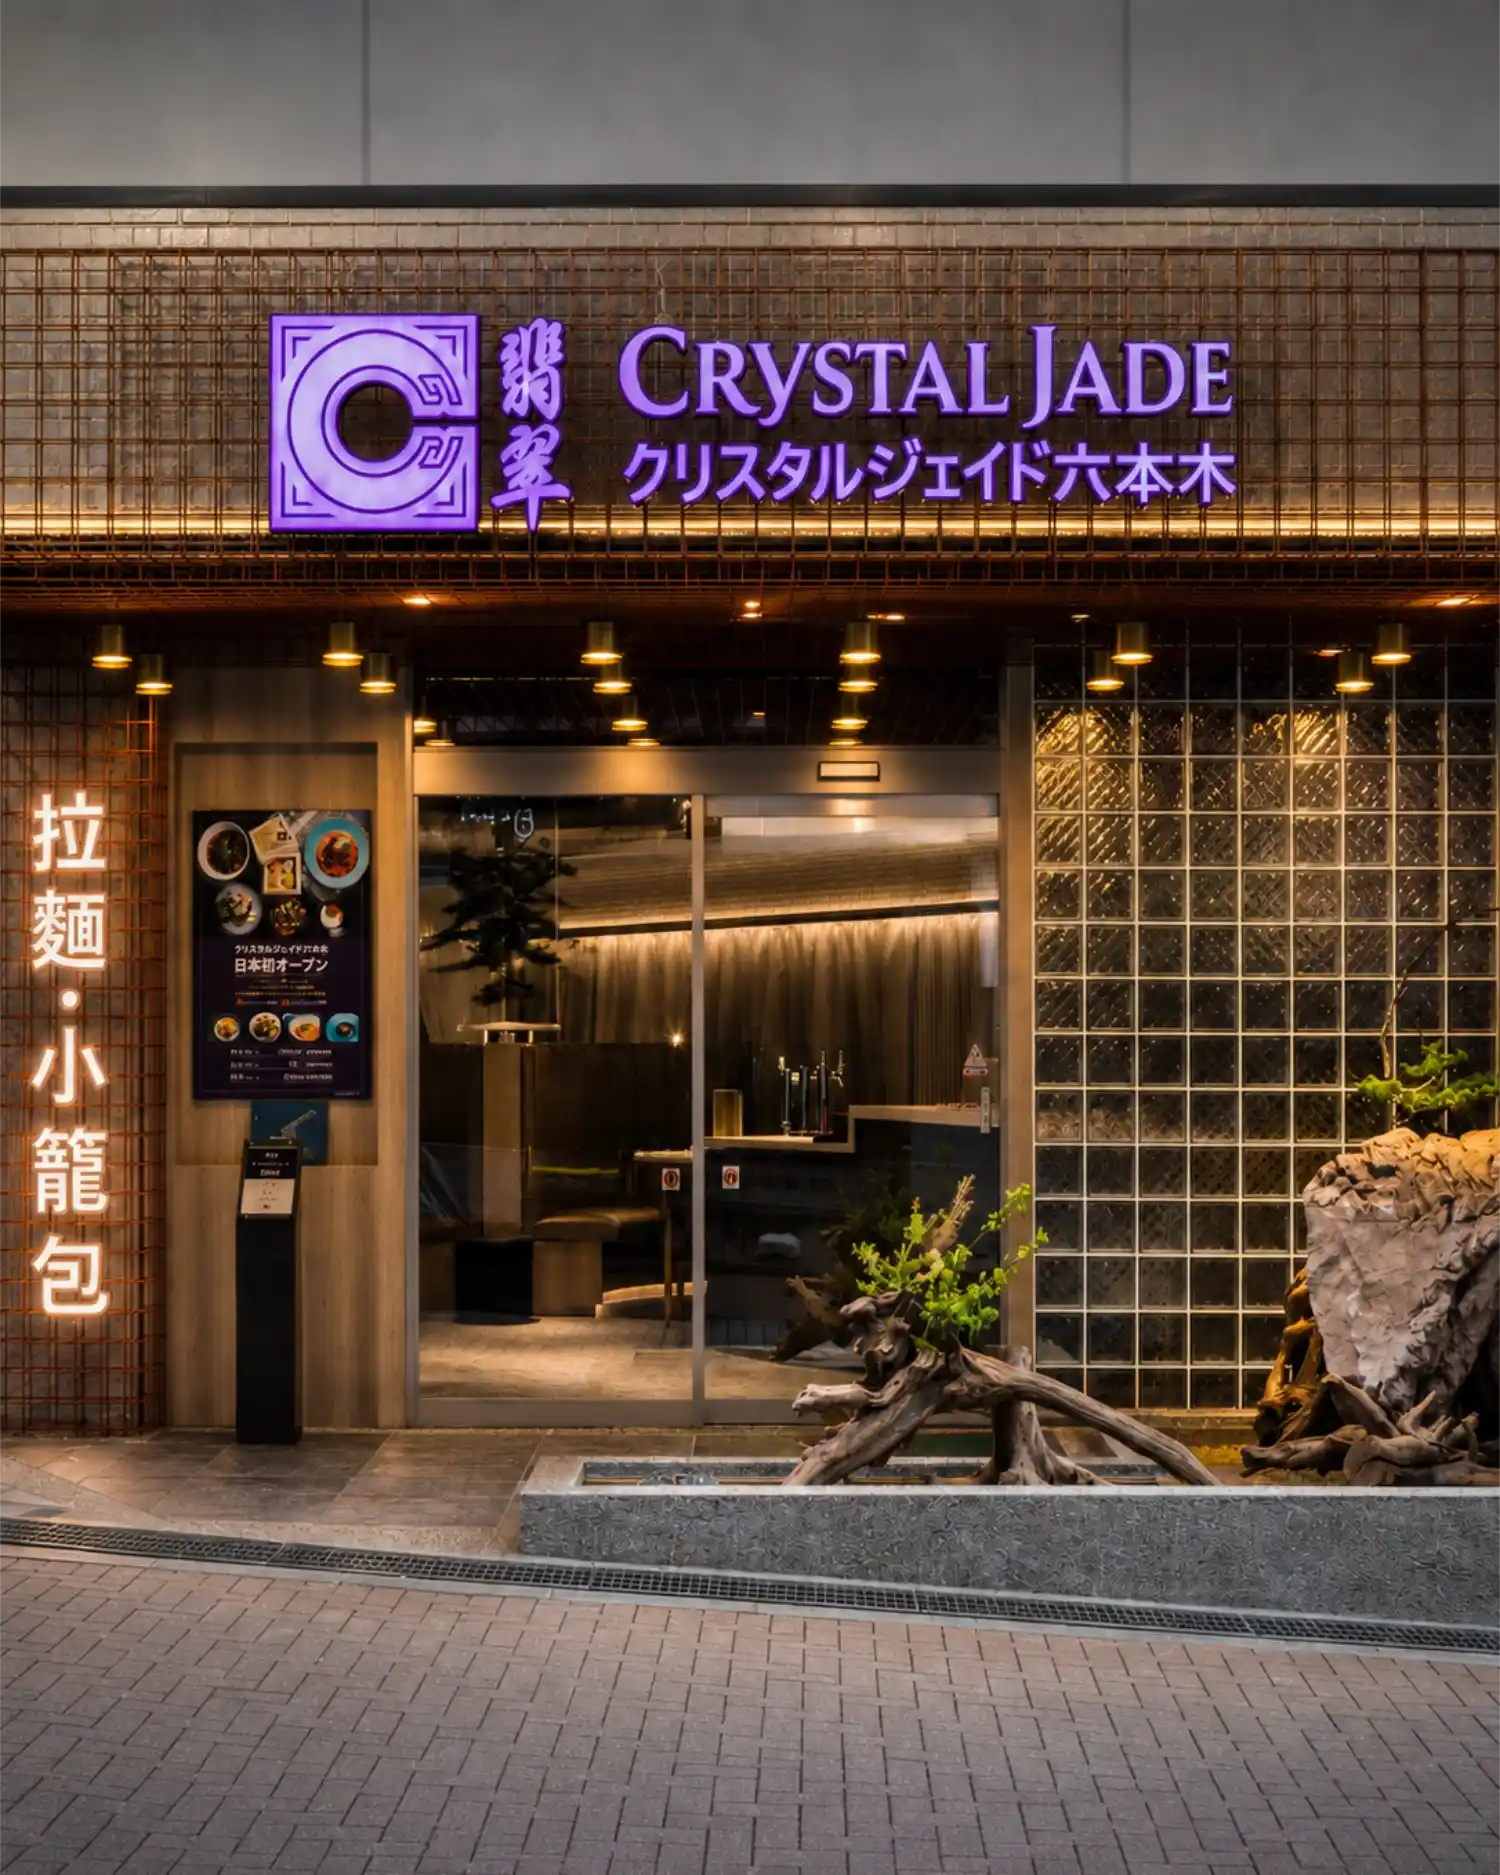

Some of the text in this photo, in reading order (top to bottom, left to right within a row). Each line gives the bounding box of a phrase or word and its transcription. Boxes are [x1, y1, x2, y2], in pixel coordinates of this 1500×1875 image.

[1020, 324, 1234, 430] JADE
[492, 317, 572, 532] 翡翠
[623, 436, 1237, 505] クリスタルジェイド六本木
[234, 957, 329, 973] 日本初オープン
